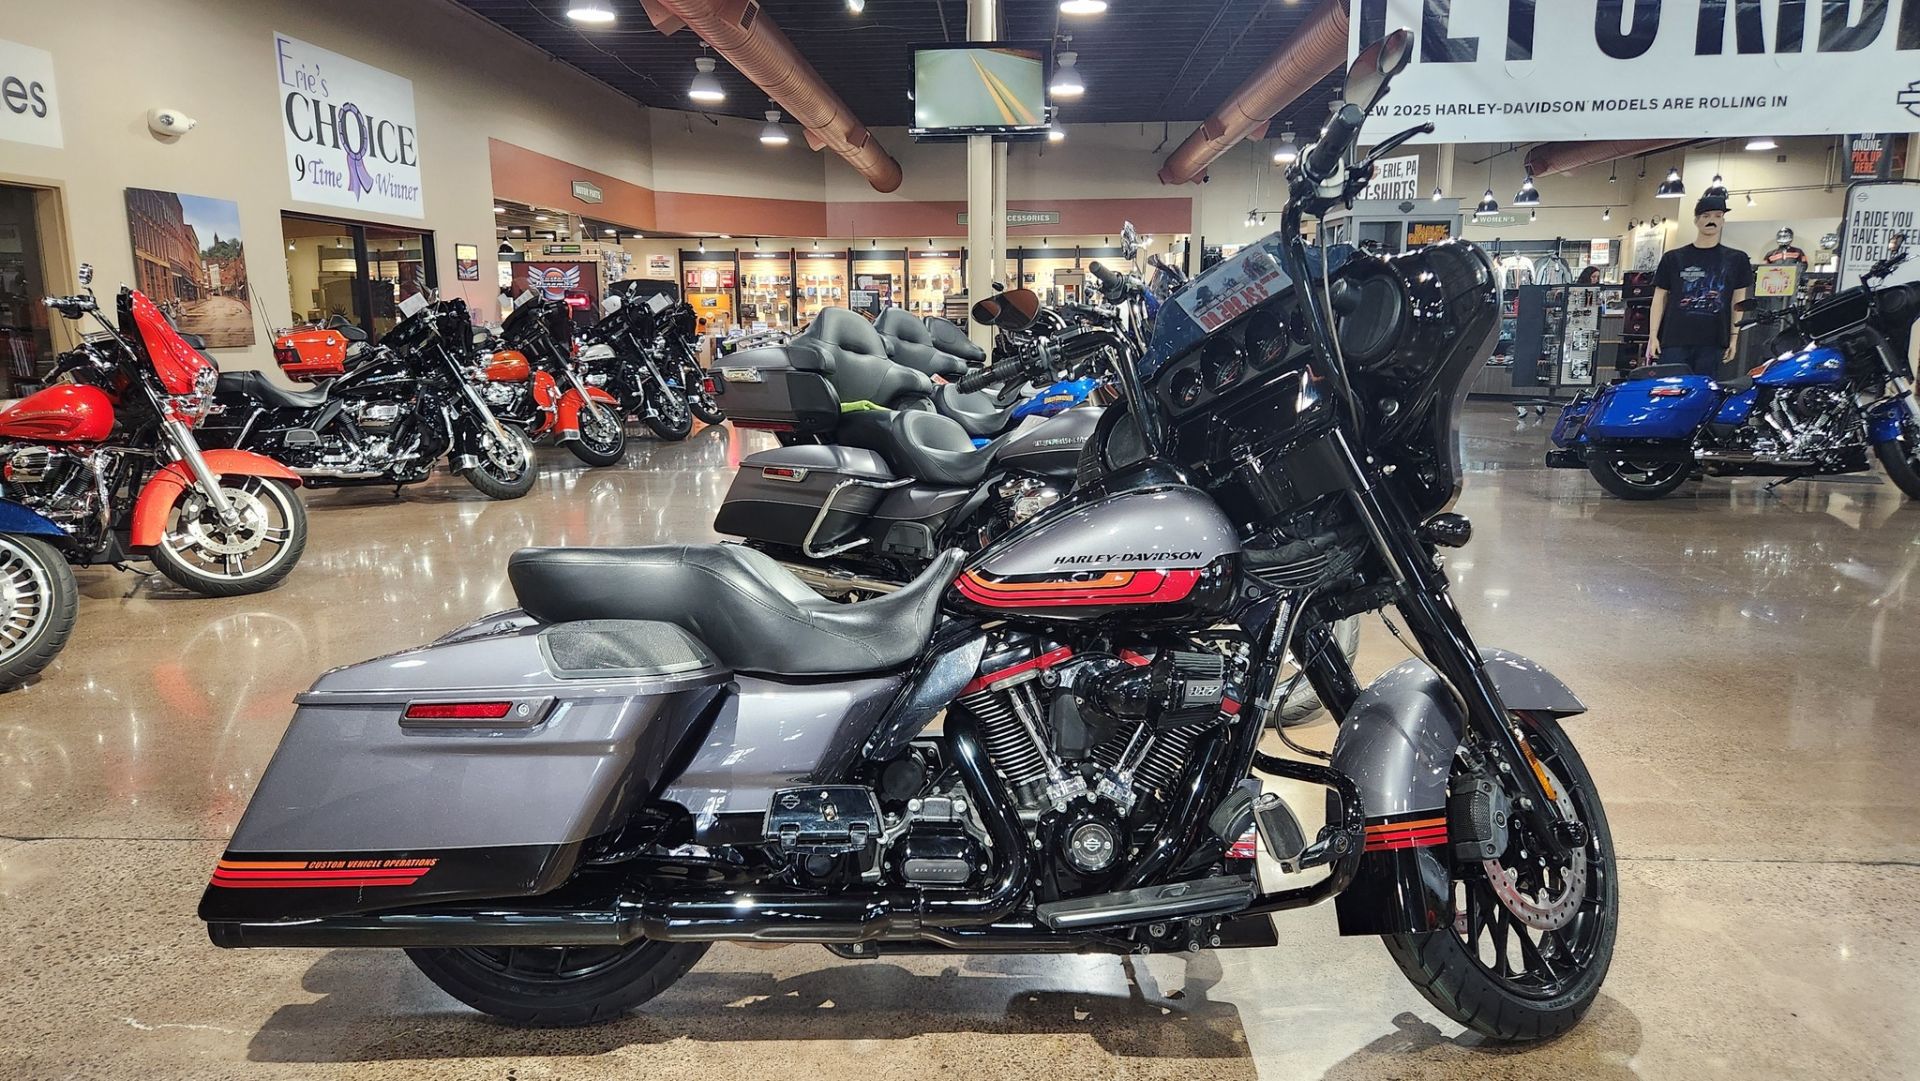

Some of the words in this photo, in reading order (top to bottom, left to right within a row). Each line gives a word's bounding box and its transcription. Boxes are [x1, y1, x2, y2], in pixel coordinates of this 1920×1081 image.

[277, 38, 329, 98] Erie's
[2, 75, 47, 119] es
[1367, 105, 1389, 117] EW
[1393, 104, 1431, 116] 2025
[1435, 101, 1587, 116] HARLEY-DAVIDSON
[1591, 99, 1659, 112] MODELS
[1662, 97, 1695, 110] ARE
[1698, 96, 1767, 109] ROLLING
[1771, 95, 1788, 108] IN
[285, 91, 417, 167] CHOICE
[295, 153, 306, 182] 9
[308, 159, 343, 189] Time
[375, 173, 419, 202] Winner
[1383, 162, 1403, 179] ERIE,
[1406, 160, 1417, 176] PA
[1365, 179, 1416, 200] T-SHIRTS
[1006, 214, 1050, 222] CESSORIES
[1853, 211, 1861, 227] A
[1863, 211, 1889, 227] RIDE
[1892, 212, 1914, 228] YOU
[1851, 228, 1880, 245] HAVE
[1850, 246, 1863, 261] TO
[1053, 551, 1203, 565] HARLEY-DAVIDSON
[1189, 685, 1220, 697] 117
[308, 860, 346, 869] CUSTOM
[347, 860, 383, 869] VEHICLE
[383, 858, 437, 868] OPERATIONS
